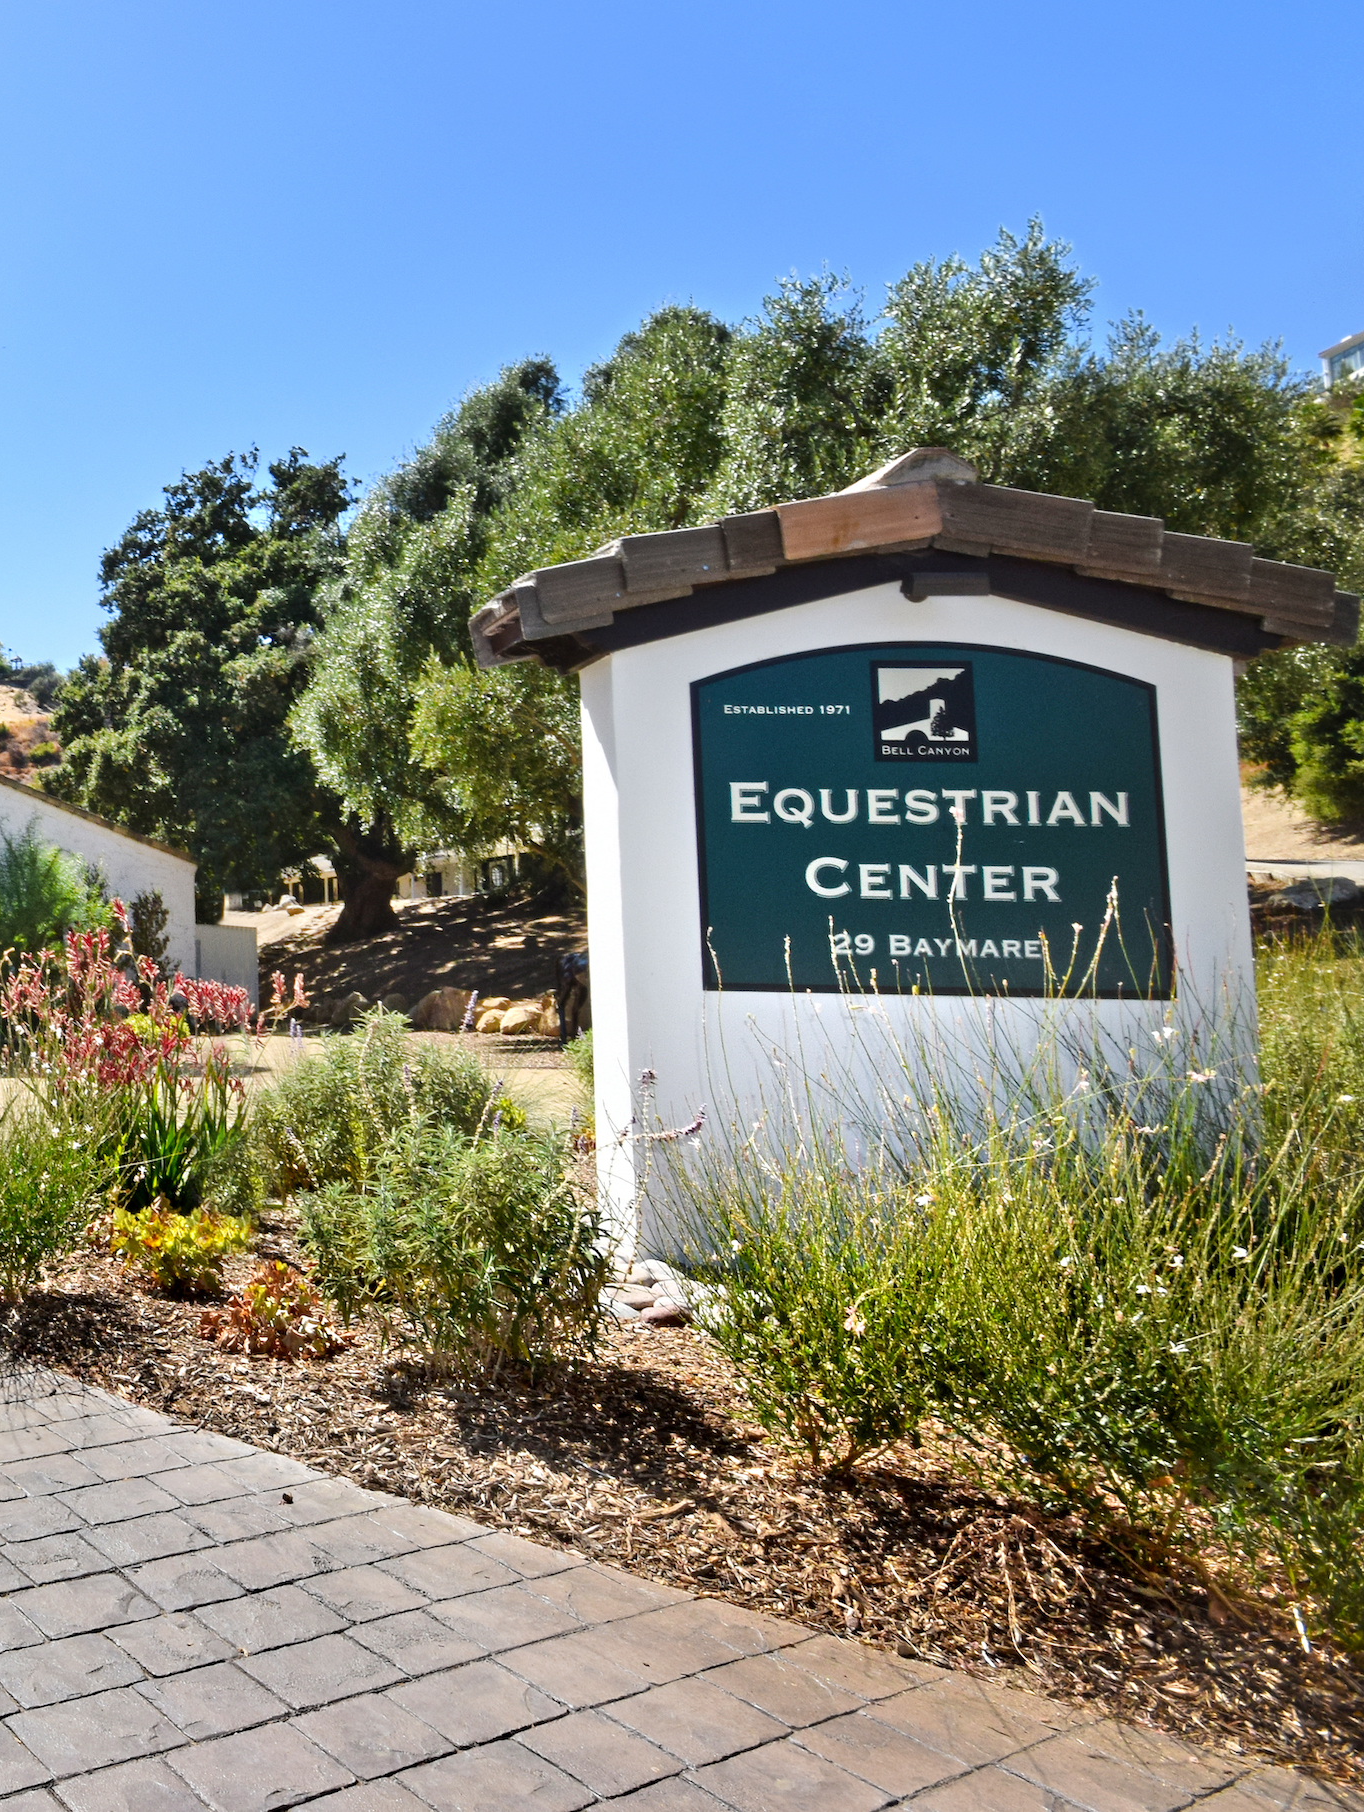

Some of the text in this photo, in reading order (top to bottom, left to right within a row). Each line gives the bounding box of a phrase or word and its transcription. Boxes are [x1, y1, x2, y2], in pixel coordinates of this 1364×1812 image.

[723, 704, 851, 715] ESTABLISHED 1971
[882, 745, 970, 756] BELL CANYON
[729, 781, 1131, 829] EQUESTRIAN
[805, 857, 1062, 902] CENTER
[834, 933, 1042, 959] 29 BAYMARE
